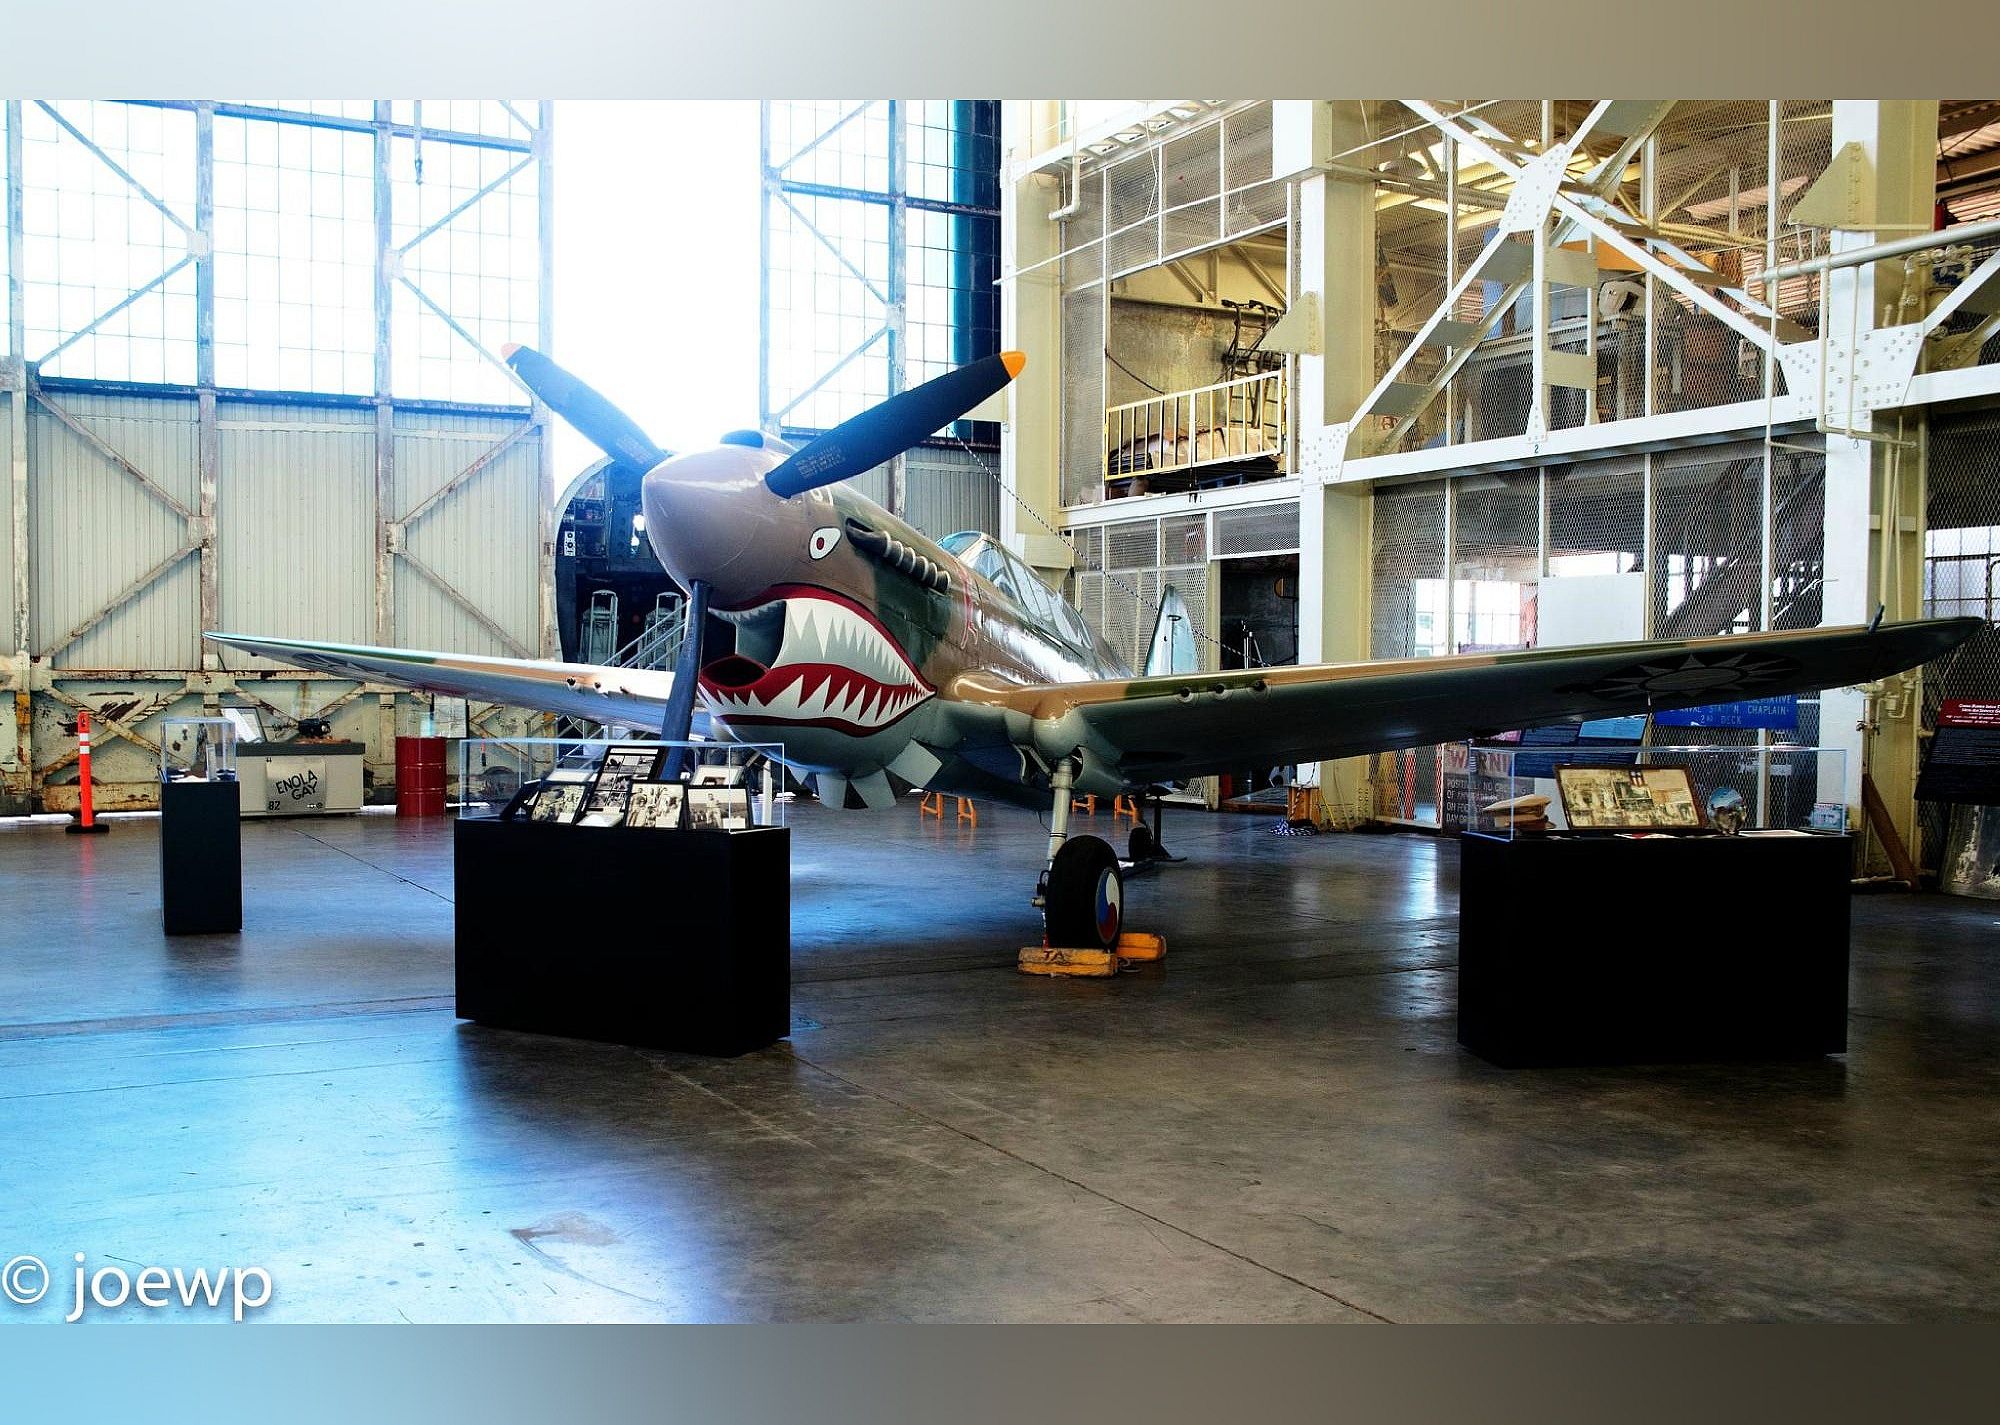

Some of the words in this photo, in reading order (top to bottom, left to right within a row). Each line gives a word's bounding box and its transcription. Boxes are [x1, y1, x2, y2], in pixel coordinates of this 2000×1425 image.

[275, 769, 318, 795] ENOLA
[291, 780, 318, 800] GAY
[268, 800, 281, 811] 82
